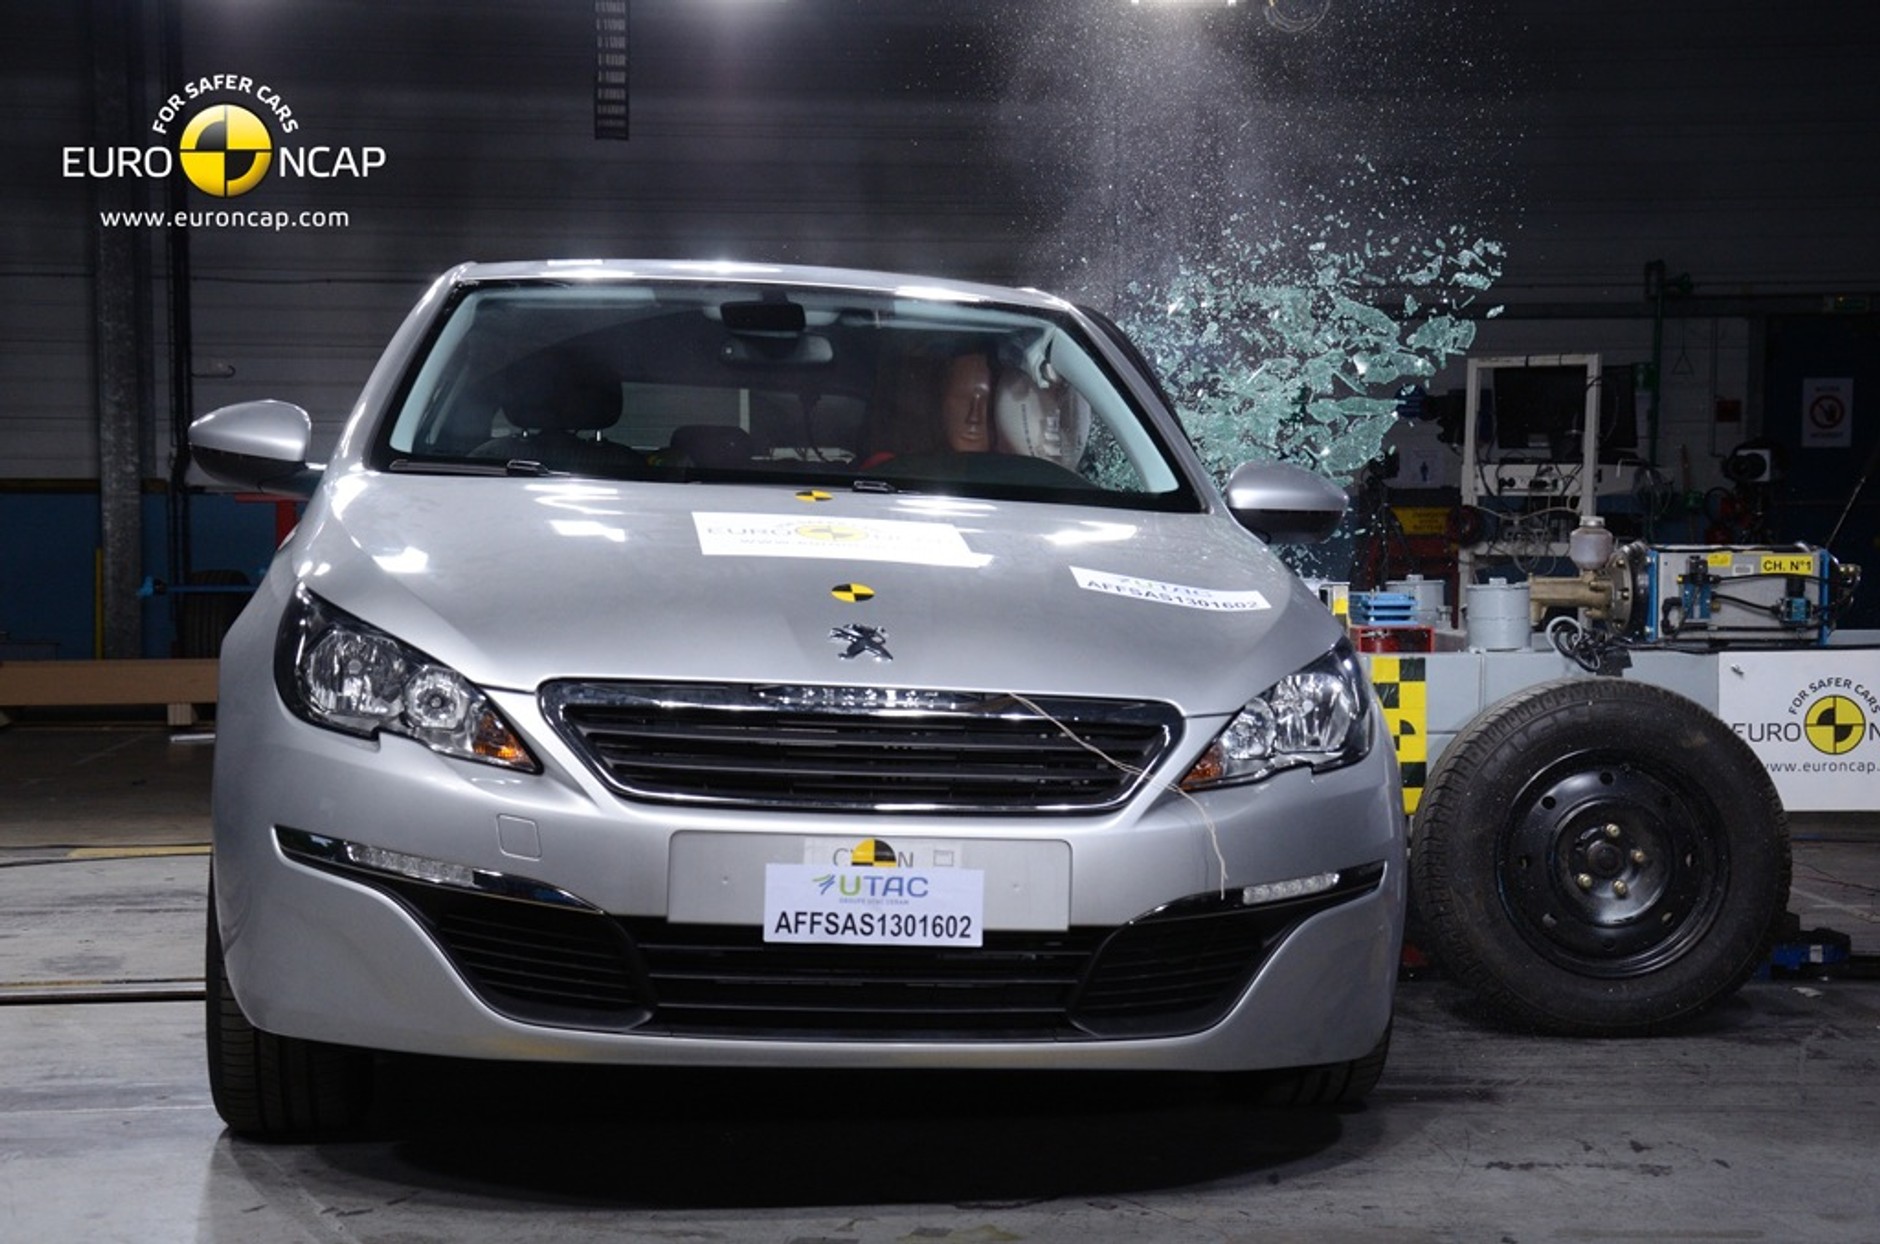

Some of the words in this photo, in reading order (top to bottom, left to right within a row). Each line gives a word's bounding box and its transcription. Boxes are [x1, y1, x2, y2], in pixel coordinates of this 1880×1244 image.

[1762, 560, 1786, 572] CH.
[1087, 580, 1258, 609] AFFSAS1301602
[1788, 689, 1809, 716] FOR
[1808, 677, 1853, 693] SAFER
[1853, 684, 1880, 715] CARS
[839, 874, 929, 899] UTAC
[774, 911, 972, 939] AFFSAS1301602
